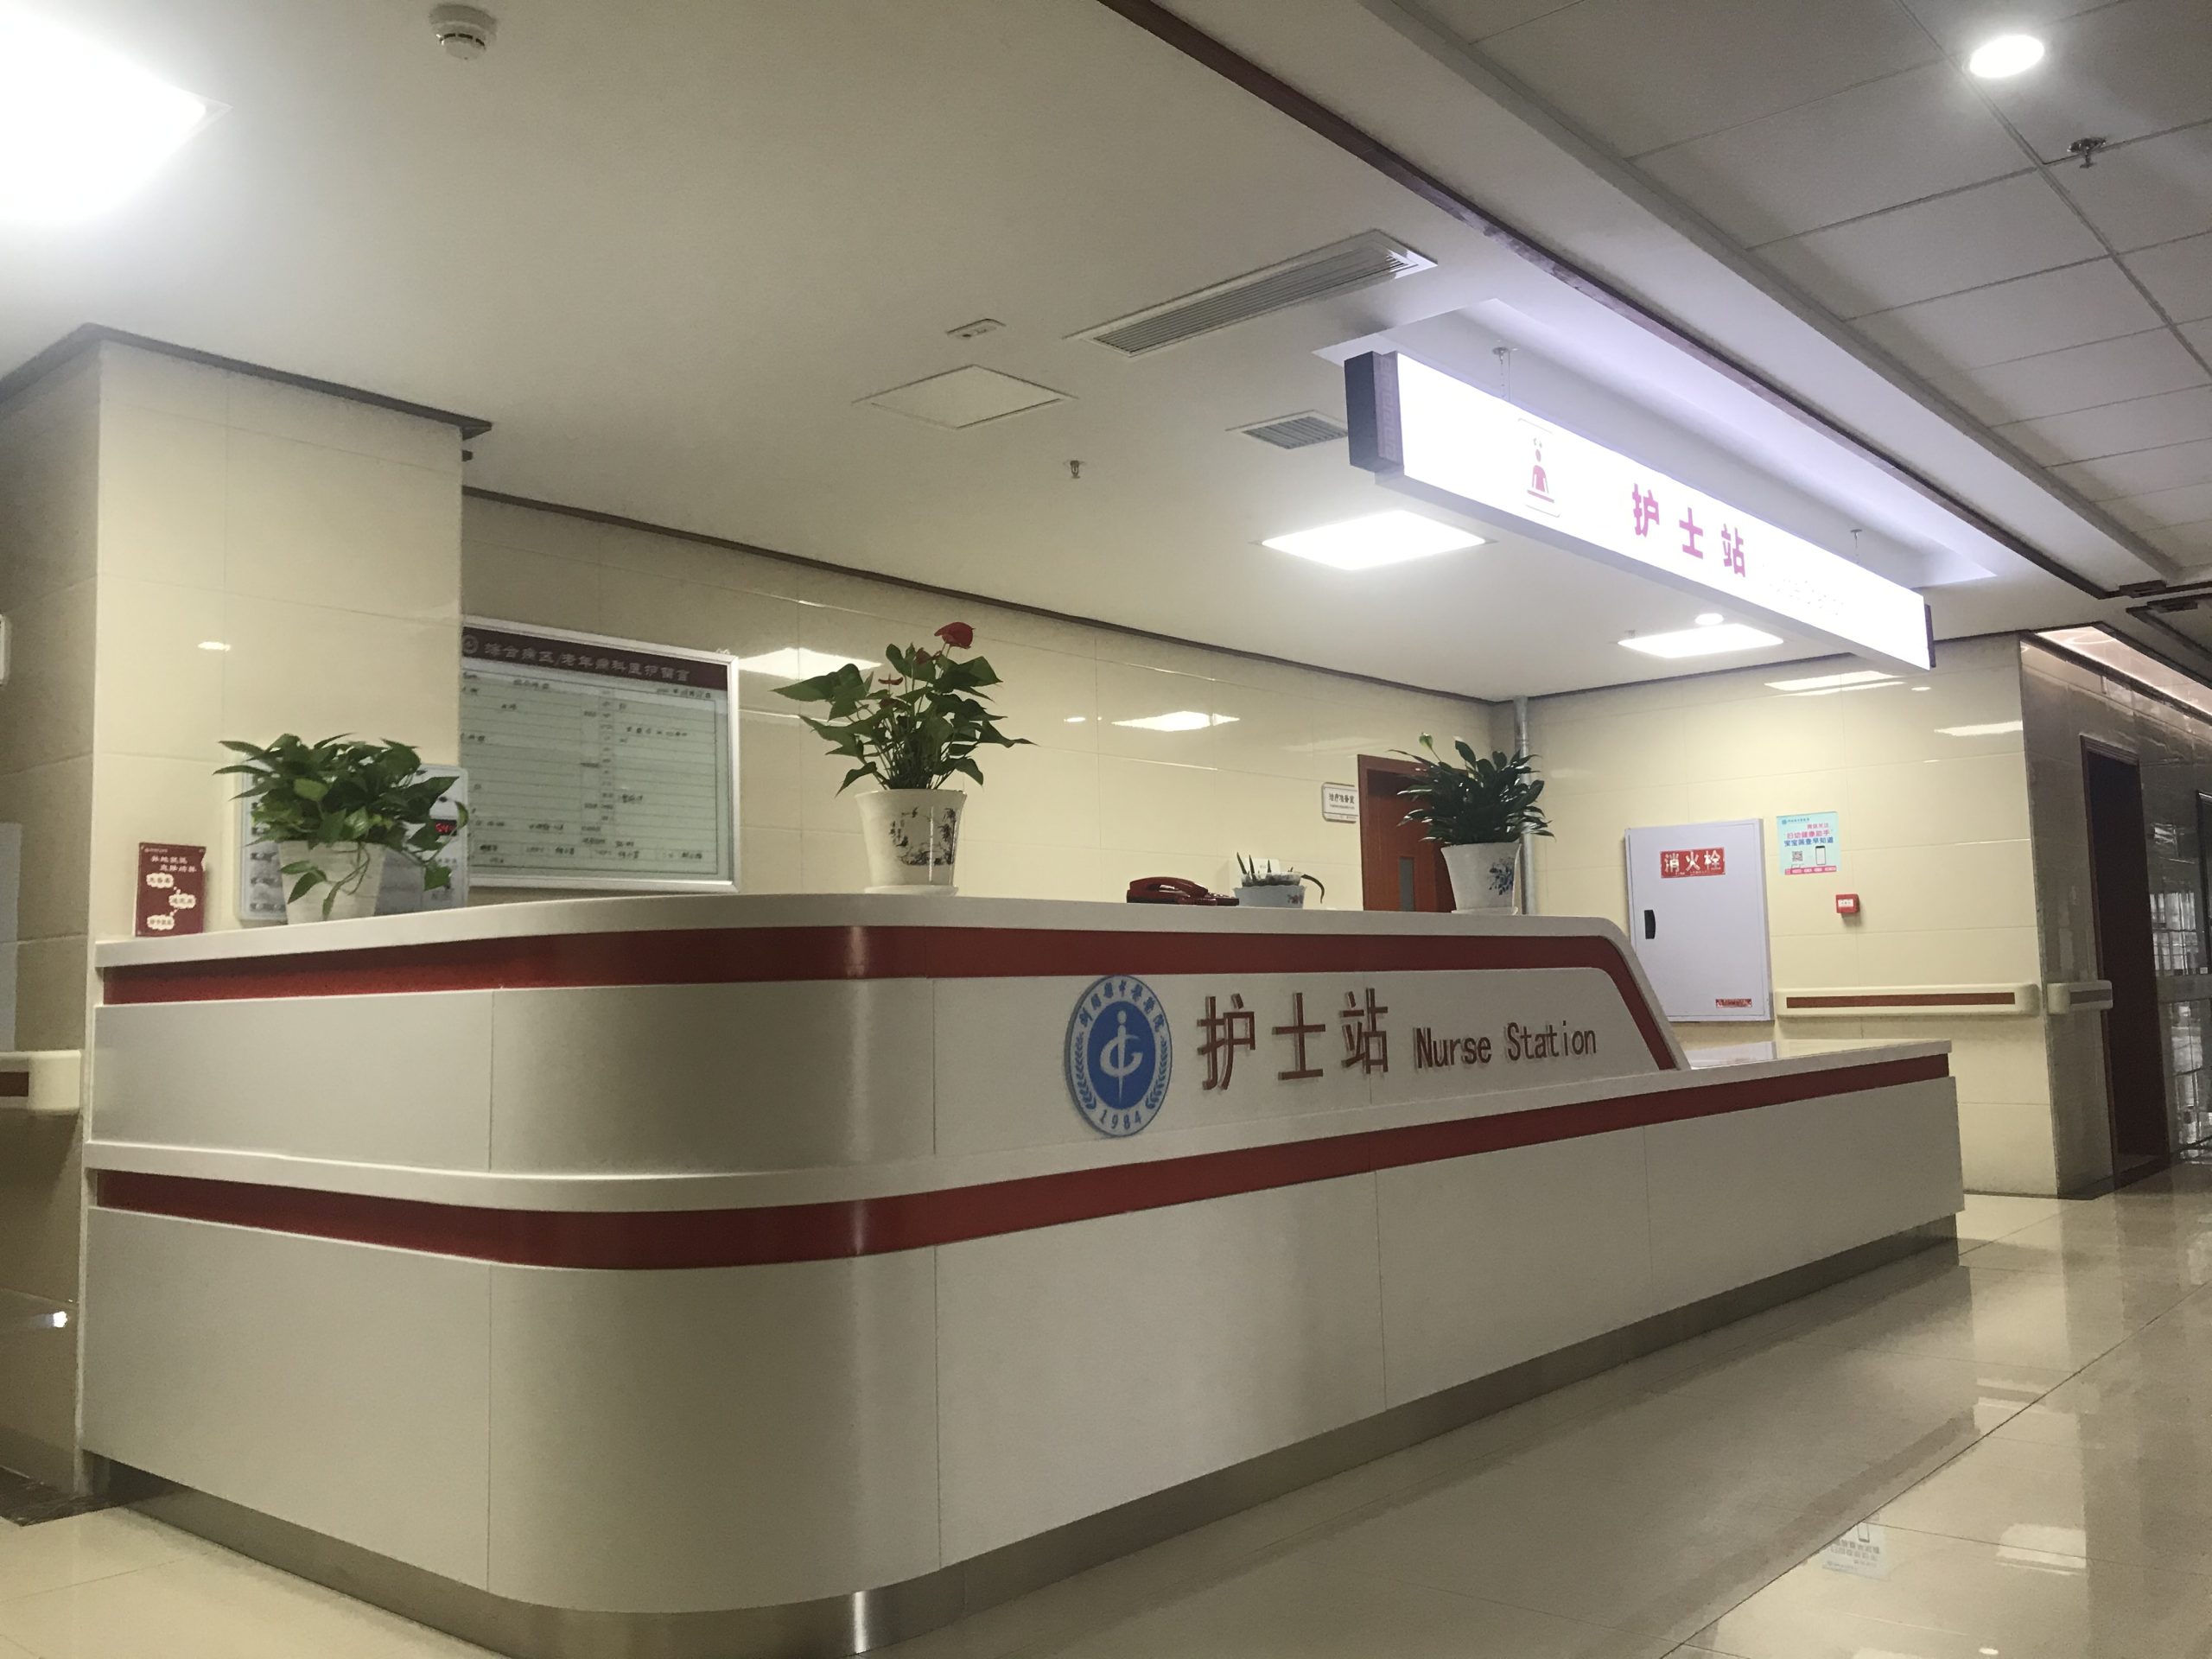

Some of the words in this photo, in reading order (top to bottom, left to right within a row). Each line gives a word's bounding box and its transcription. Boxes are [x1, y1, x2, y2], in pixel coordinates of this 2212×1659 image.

[1631, 482, 1746, 578] 护士站
[1663, 849, 1722, 873] 消火栓
[1197, 988, 1389, 1090] 护士站
[1414, 1027, 1492, 1070] Nurse
[1505, 1020, 1597, 1062] Station
[1098, 1109, 1142, 1131] 1984
